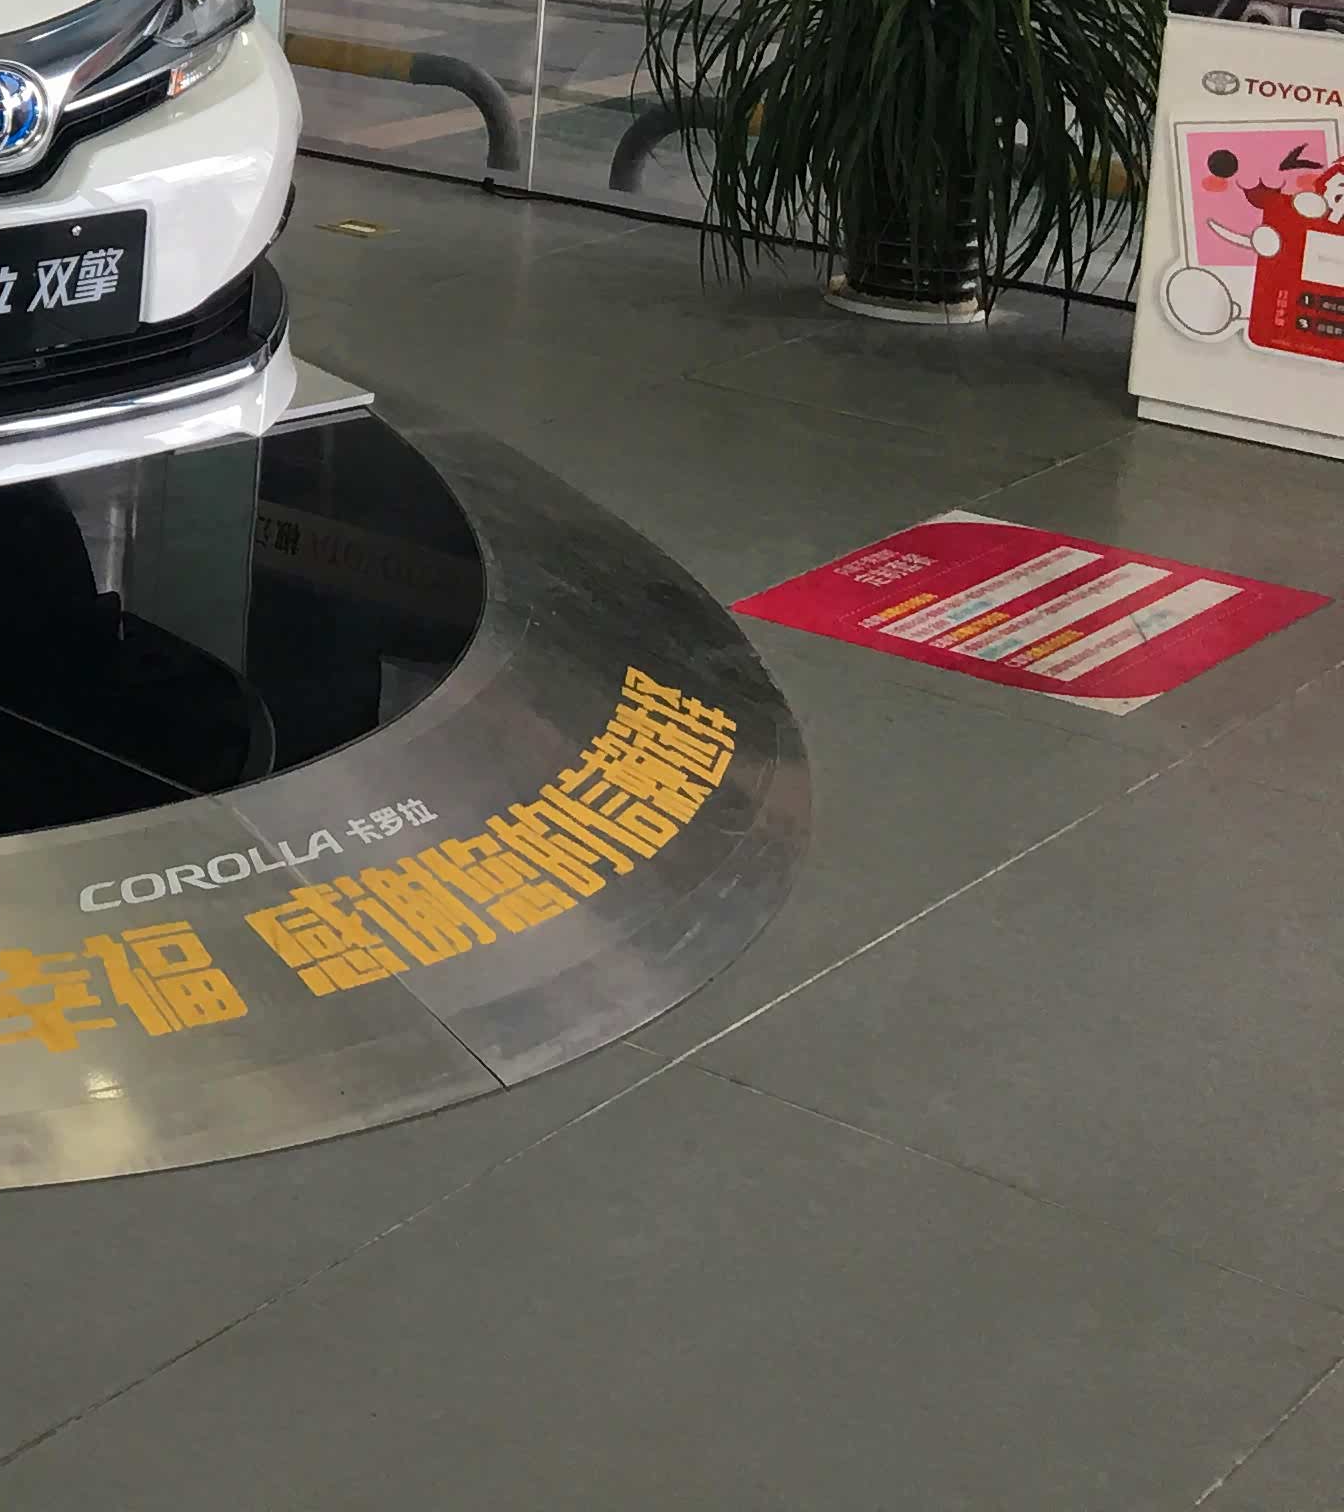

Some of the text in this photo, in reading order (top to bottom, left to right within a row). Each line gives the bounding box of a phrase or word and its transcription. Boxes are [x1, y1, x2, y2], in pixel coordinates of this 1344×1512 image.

[1244, 77, 1344, 107] TOYOTA
[27, 246, 125, 313] 双擎
[79, 796, 440, 915] COROLLA 卡罗拉
[244, 666, 739, 998] 感谢您的信赖选择
